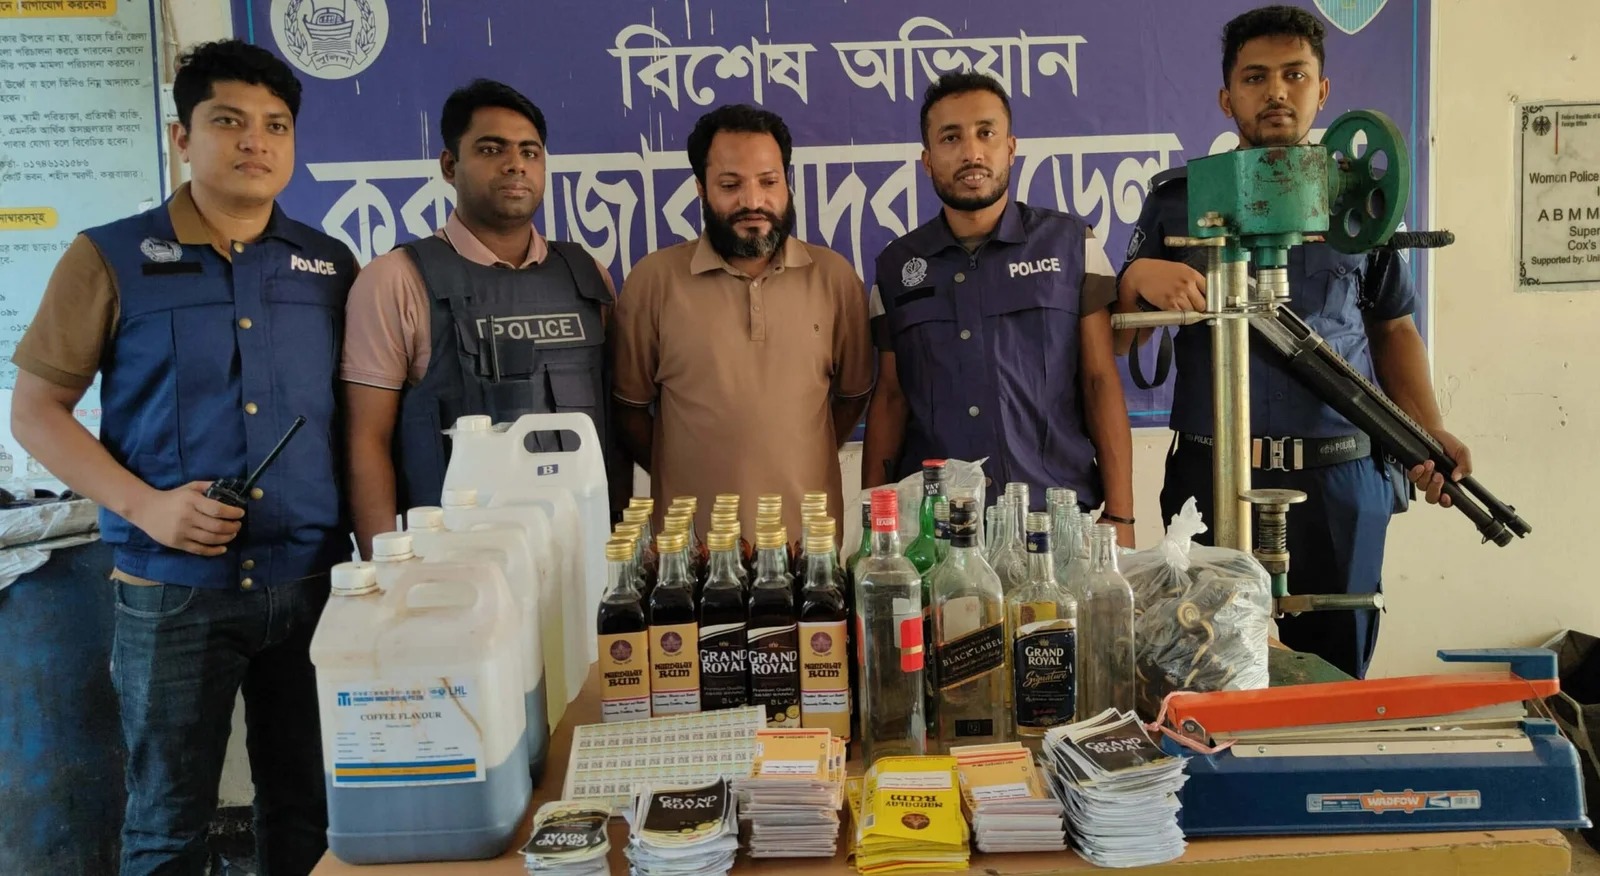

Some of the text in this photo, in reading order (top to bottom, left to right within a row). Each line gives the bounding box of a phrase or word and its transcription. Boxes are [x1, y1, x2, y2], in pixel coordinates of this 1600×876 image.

[607, 16, 1088, 111] বিশেষ অভিযান
[1569, 171, 1600, 183] Police
[1567, 239, 1597, 251] Cox's
[290, 254, 337, 275] POLICE
[1531, 255, 1571, 267] Supported
[1009, 257, 1062, 278] POLICE
[491, 319, 574, 340] POLICE
[925, 482, 940, 490] VAT
[700, 649, 748, 664] GRAND
[748, 650, 798, 665] GRAND
[942, 649, 973, 668] BLACK
[974, 637, 1003, 655] LABEL
[1025, 646, 1064, 658] GRAND
[1028, 656, 1062, 666] ROYAL
[702, 661, 748, 674] ROYAL
[751, 661, 798, 675] ROYAL
[360, 711, 442, 722] COFFEE FLAVOUR
[1084, 737, 1142, 750] GRAND
[1095, 745, 1147, 754] ROYAL
[658, 794, 718, 805] GRAND
[661, 801, 714, 810] ROYAL
[1366, 796, 1420, 807] WADFOW
[535, 838, 589, 847] GRAND
[542, 832, 588, 841] ROYAL
